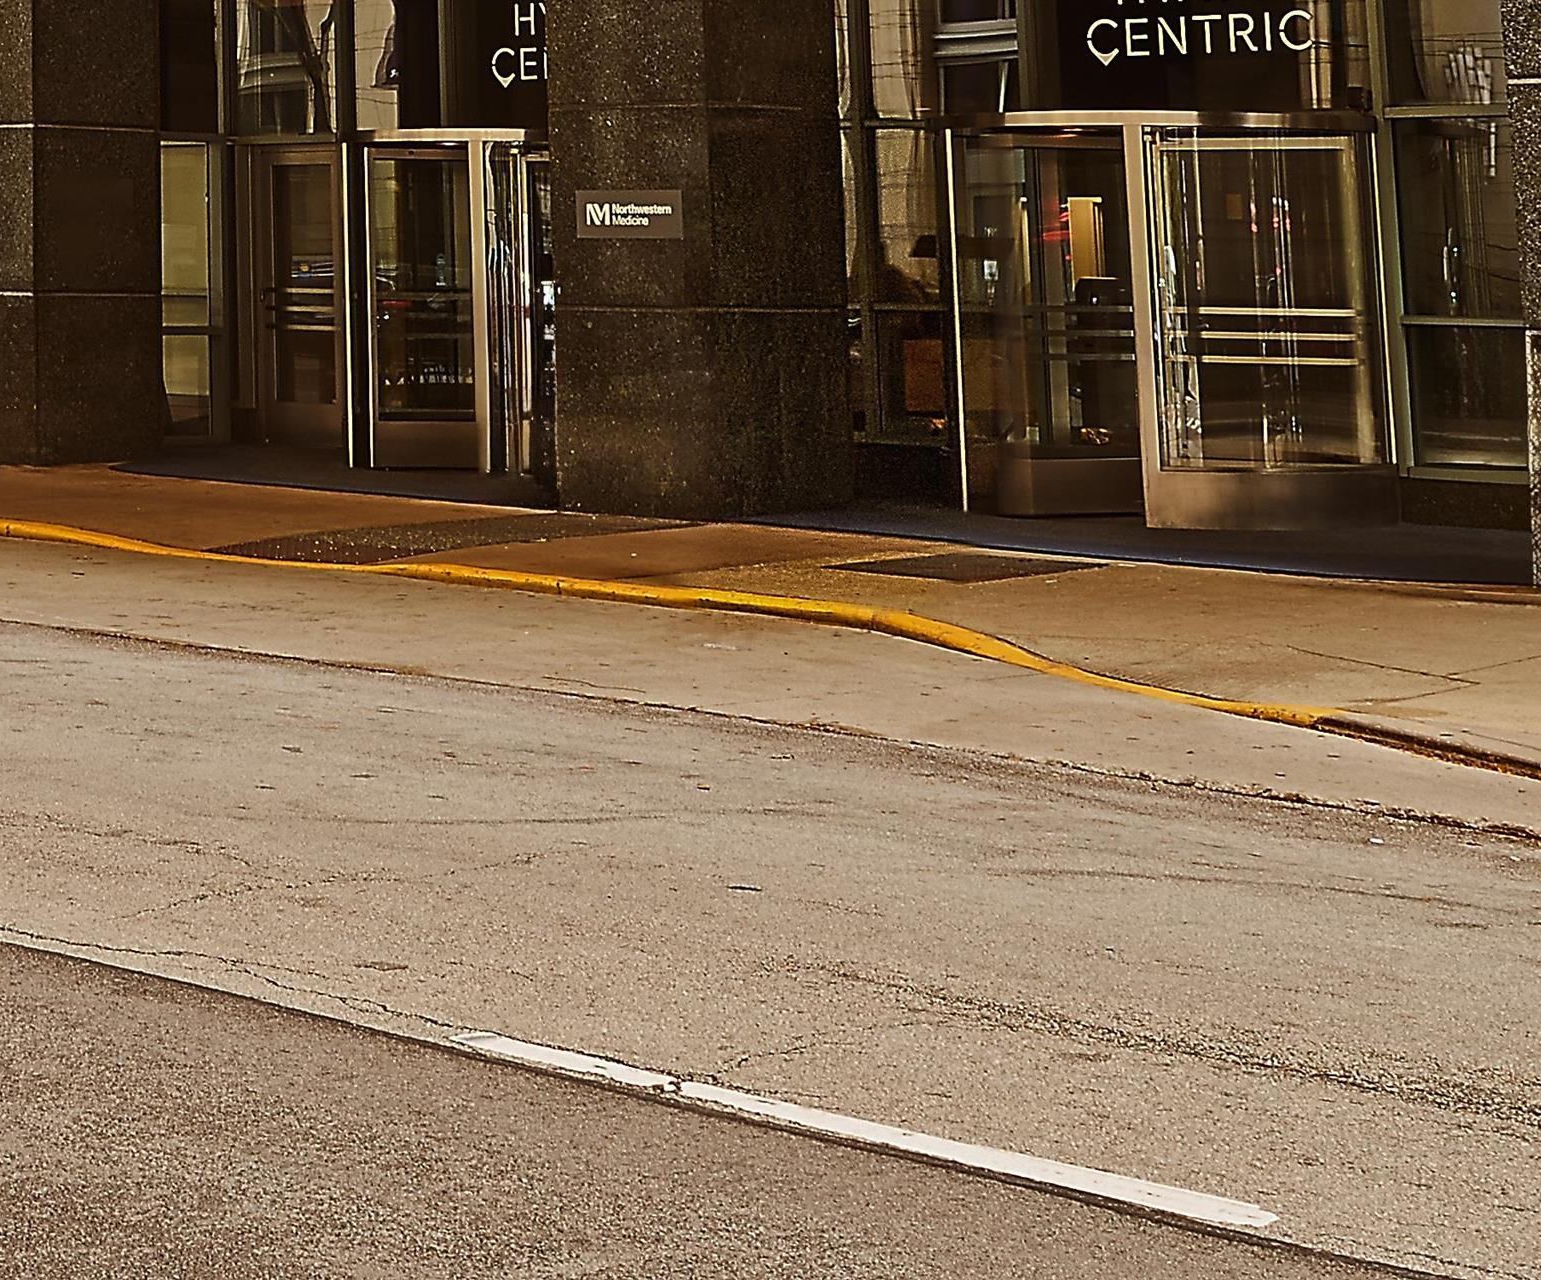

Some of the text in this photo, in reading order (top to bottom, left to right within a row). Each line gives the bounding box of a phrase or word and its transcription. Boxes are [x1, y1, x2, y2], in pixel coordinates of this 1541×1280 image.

[1086, 9, 1314, 67] CENTRIC
[612, 203, 672, 215] Northwestern
[612, 215, 649, 226] Medicine
